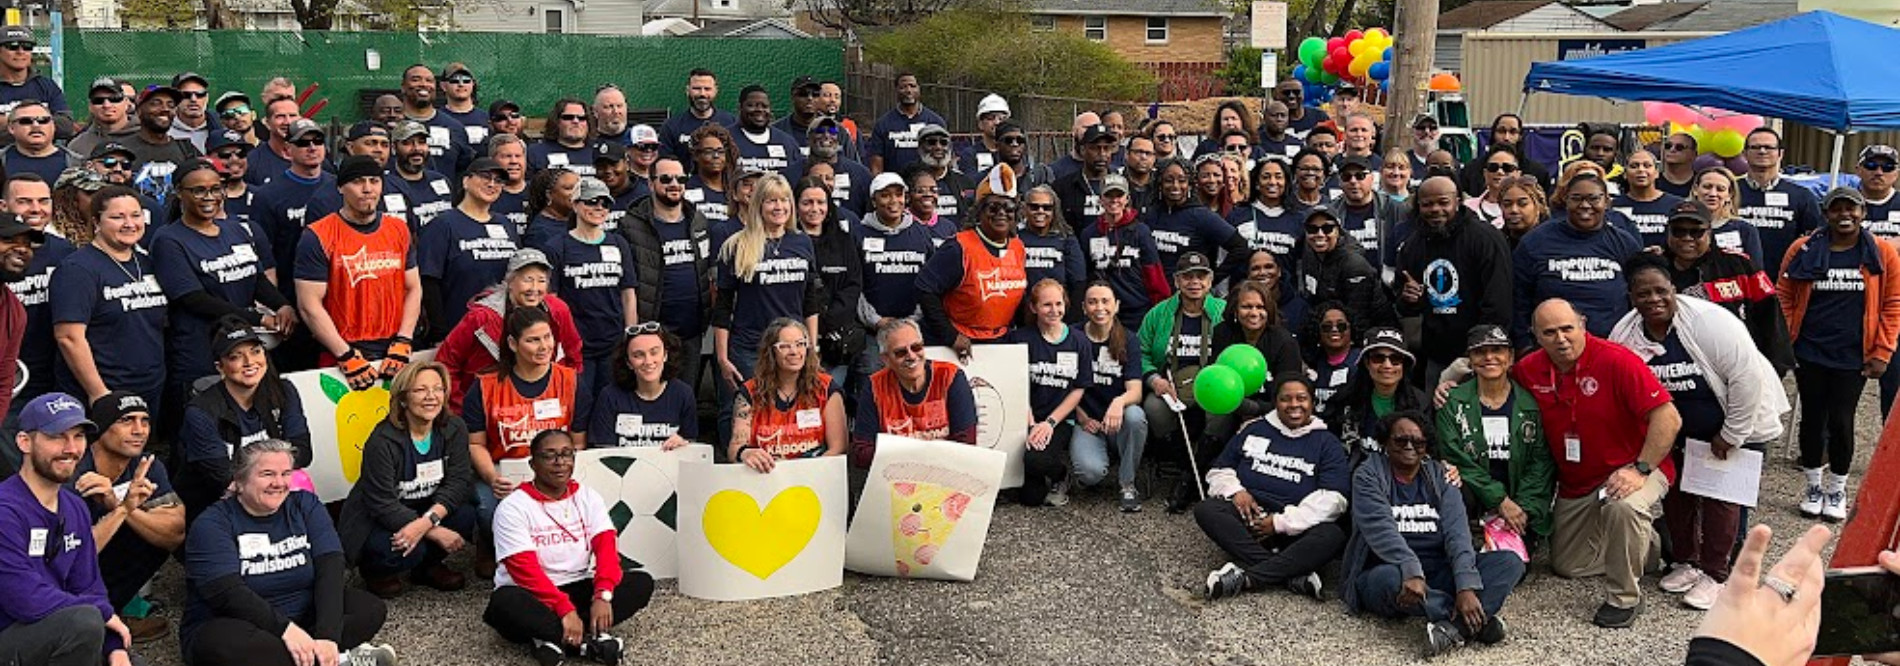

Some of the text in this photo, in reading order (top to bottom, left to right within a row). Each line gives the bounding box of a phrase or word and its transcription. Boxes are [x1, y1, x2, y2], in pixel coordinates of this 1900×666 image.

[875, 262, 920, 274] Paulsboro
[1561, 268, 1615, 281] Paulsboro
[574, 274, 620, 290] Paulsboro
[759, 269, 805, 284] Paulsboro
[1251, 459, 1302, 483] Paulsboro
[241, 554, 306, 577] Paulsboro
